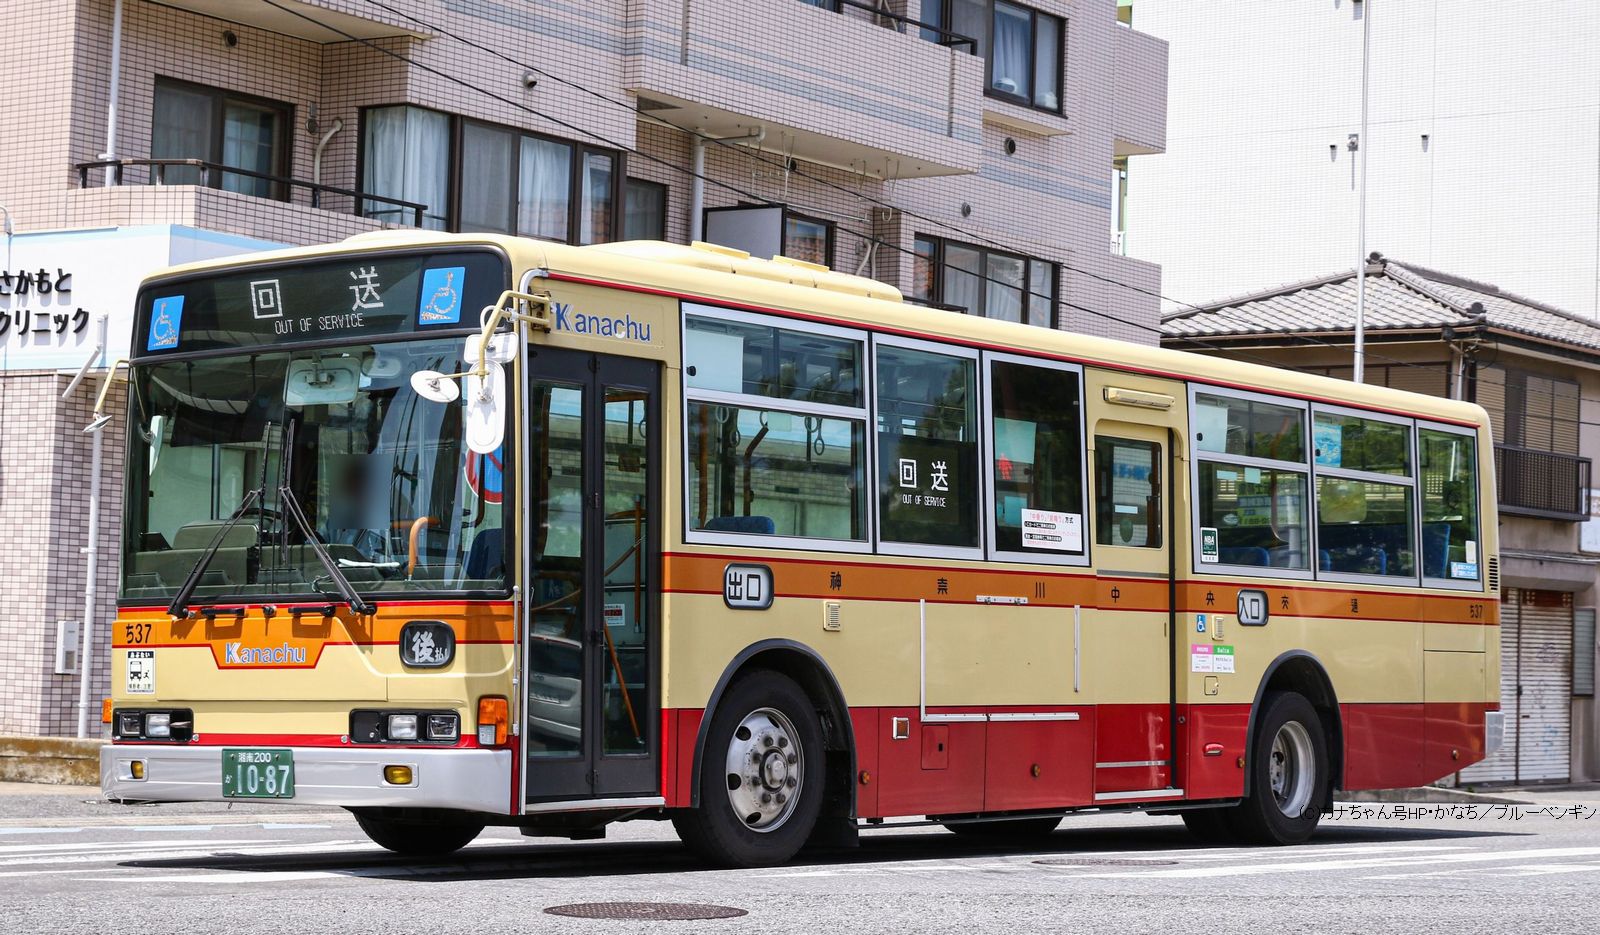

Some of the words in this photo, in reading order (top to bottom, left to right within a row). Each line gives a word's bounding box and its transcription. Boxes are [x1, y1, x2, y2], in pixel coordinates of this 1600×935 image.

[0, 268, 72, 296] さかもと
[250, 266, 384, 321] 回送
[0, 307, 89, 336] クリニック
[274, 320, 294, 336] OUT
[299, 318, 313, 334] OF
[318, 313, 365, 334] SERVICE
[551, 302, 652, 342] Kanachu
[899, 458, 949, 492] 回送
[902, 494, 912, 505] OUT
[914, 495, 923, 505] OF
[924, 496, 947, 508] SERVICE
[728, 571, 761, 601] 出口
[1239, 597, 1260, 620] 入口
[1469, 604, 1483, 618] 537
[126, 623, 152, 644] ち537
[225, 642, 306, 664] Kanachu
[238, 752, 272, 763] 湘南200
[224, 774, 233, 784] か
[237, 764, 290, 794] 10-87
